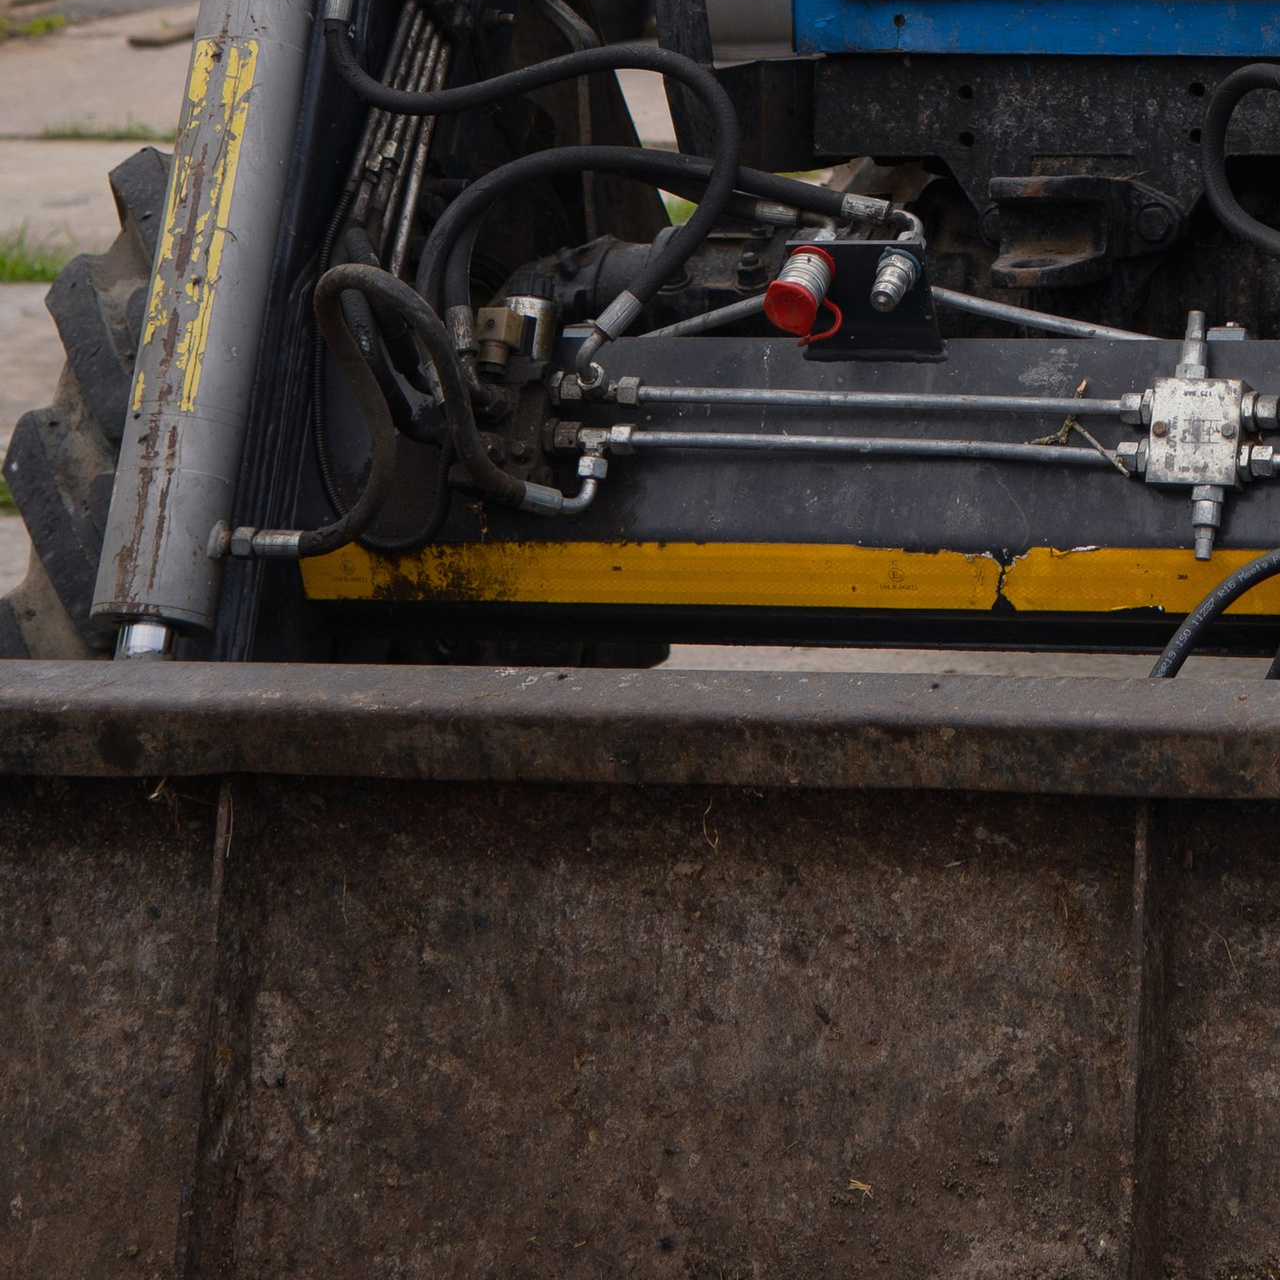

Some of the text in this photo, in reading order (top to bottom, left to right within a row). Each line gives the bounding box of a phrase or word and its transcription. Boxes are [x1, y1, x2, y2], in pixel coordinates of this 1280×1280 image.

[1176, 628, 1192, 648] ISO
[1191, 598, 1215, 626] 11237
[1217, 580, 1236, 598] R16
[1237, 561, 1268, 582] Meets
